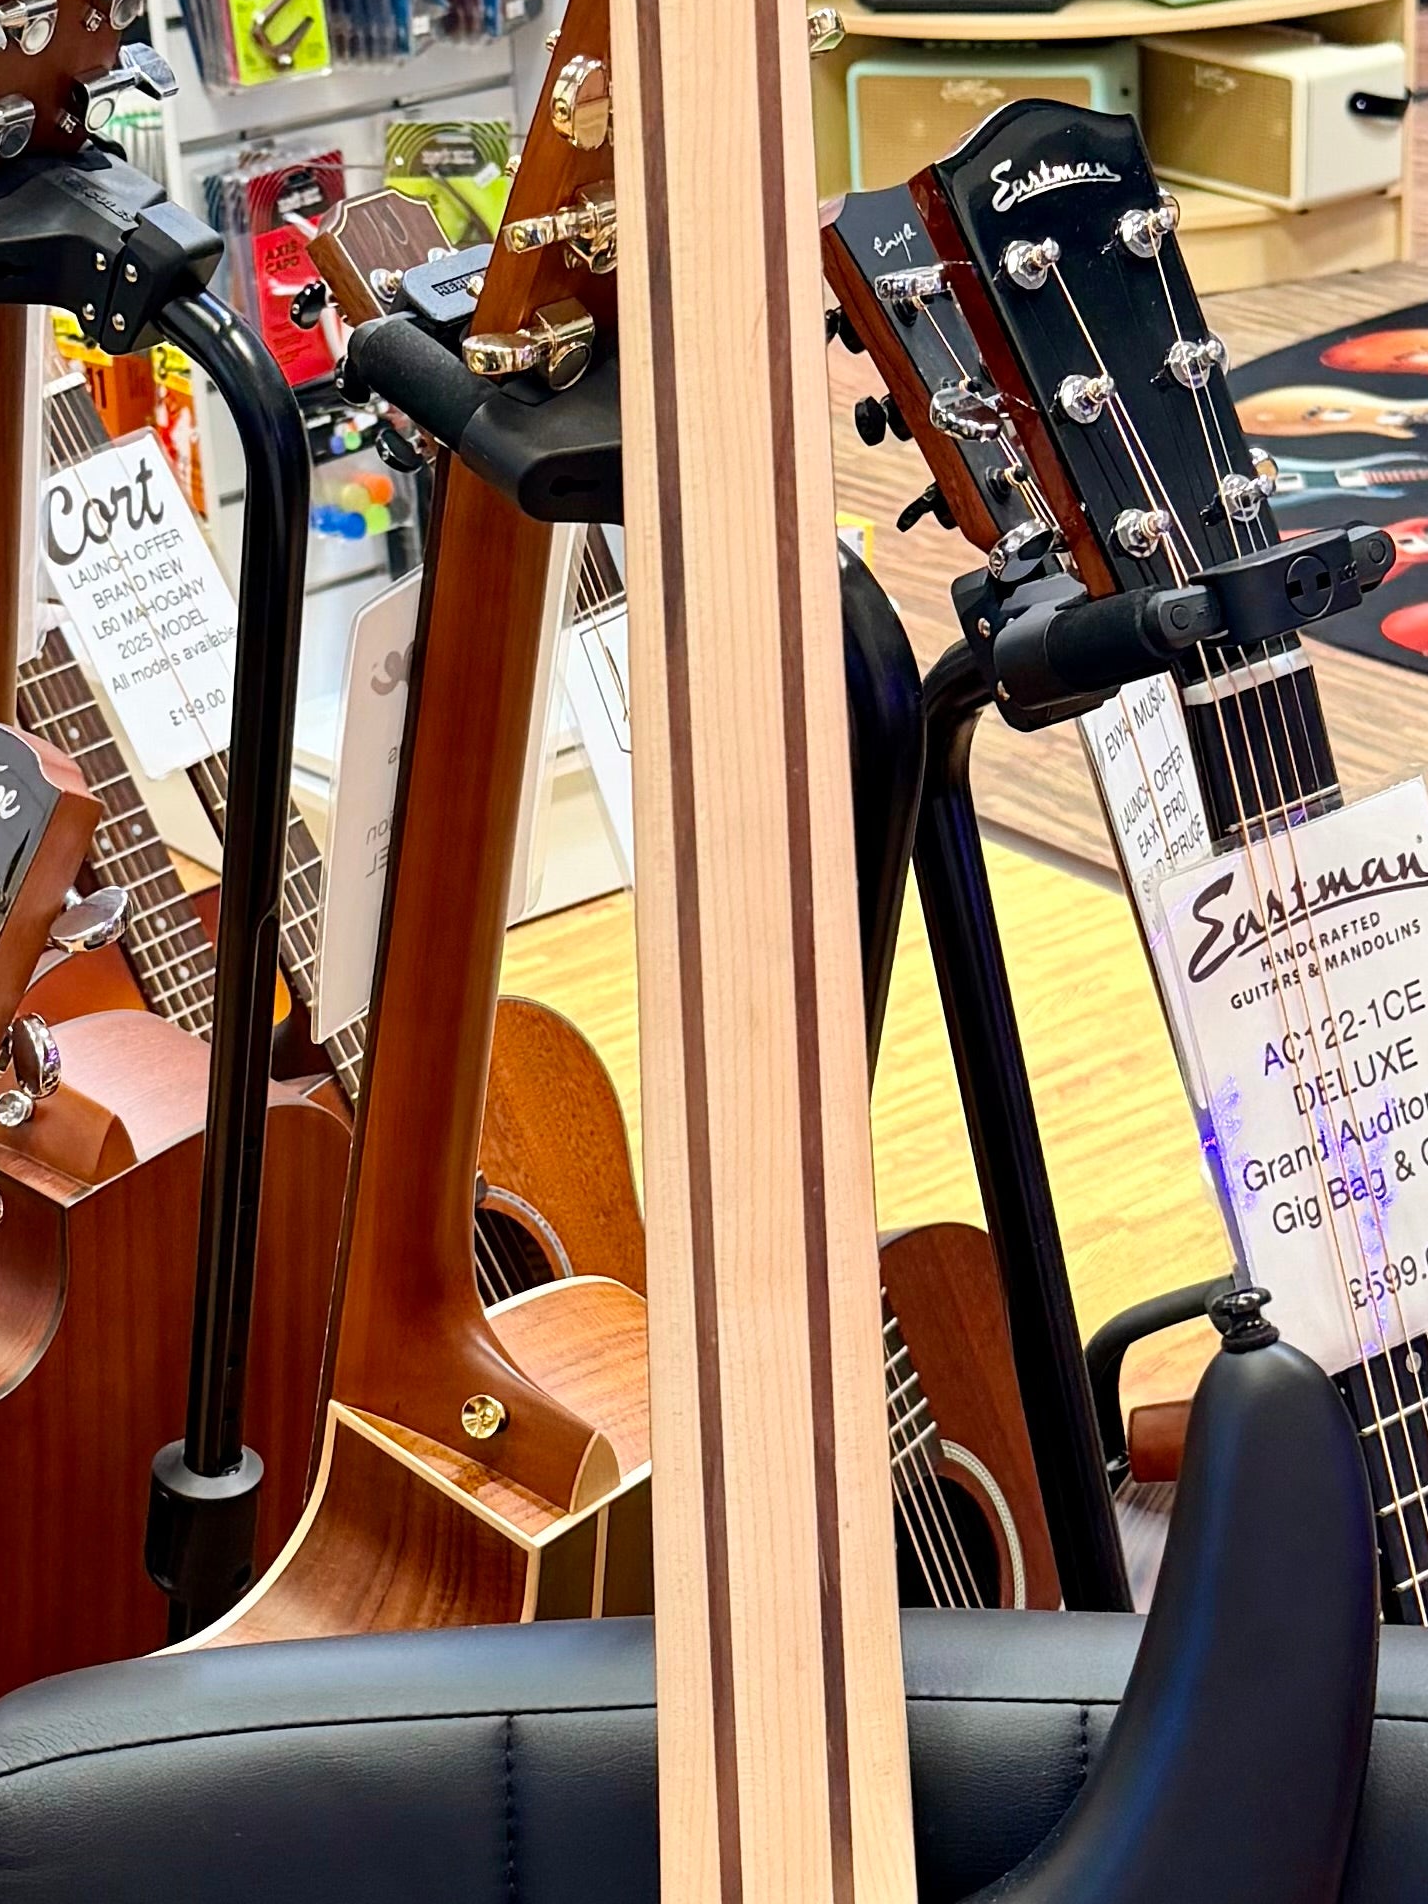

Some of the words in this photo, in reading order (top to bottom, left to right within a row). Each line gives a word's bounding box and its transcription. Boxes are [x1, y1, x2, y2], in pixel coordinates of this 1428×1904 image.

[991, 158, 1122, 213] Eastman
[45, 456, 165, 567] Cort
[67, 549, 134, 591] LAUNCH
[133, 528, 185, 561] OFFER
[92, 574, 148, 611] BRAND
[148, 556, 185, 585] NEW
[92, 614, 122, 641] L60
[120, 576, 207, 628] MAHOGANY
[117, 631, 154, 661] 2025
[154, 607, 210, 642] MODEL
[111, 672, 130, 695] All
[182, 626, 238, 662] available
[168, 688, 228, 728] £199.00
[1132, 676, 1168, 730] MUSIC
[1153, 744, 1185, 793] OFFER
[1163, 790, 1188, 828] PRO
[1230, 968, 1301, 1010] GUITARS
[1308, 962, 1320, 979] &
[1324, 918, 1422, 973] MANDOLINS
[1260, 910, 1381, 973] HANDCRAFTED
[1292, 1036, 1419, 1117] DELUXE
[1242, 1129, 1330, 1193] Grand
[1272, 1195, 1323, 1235] Gig
[1327, 1167, 1388, 1212] Bag
[1393, 1149, 1417, 1183] &
